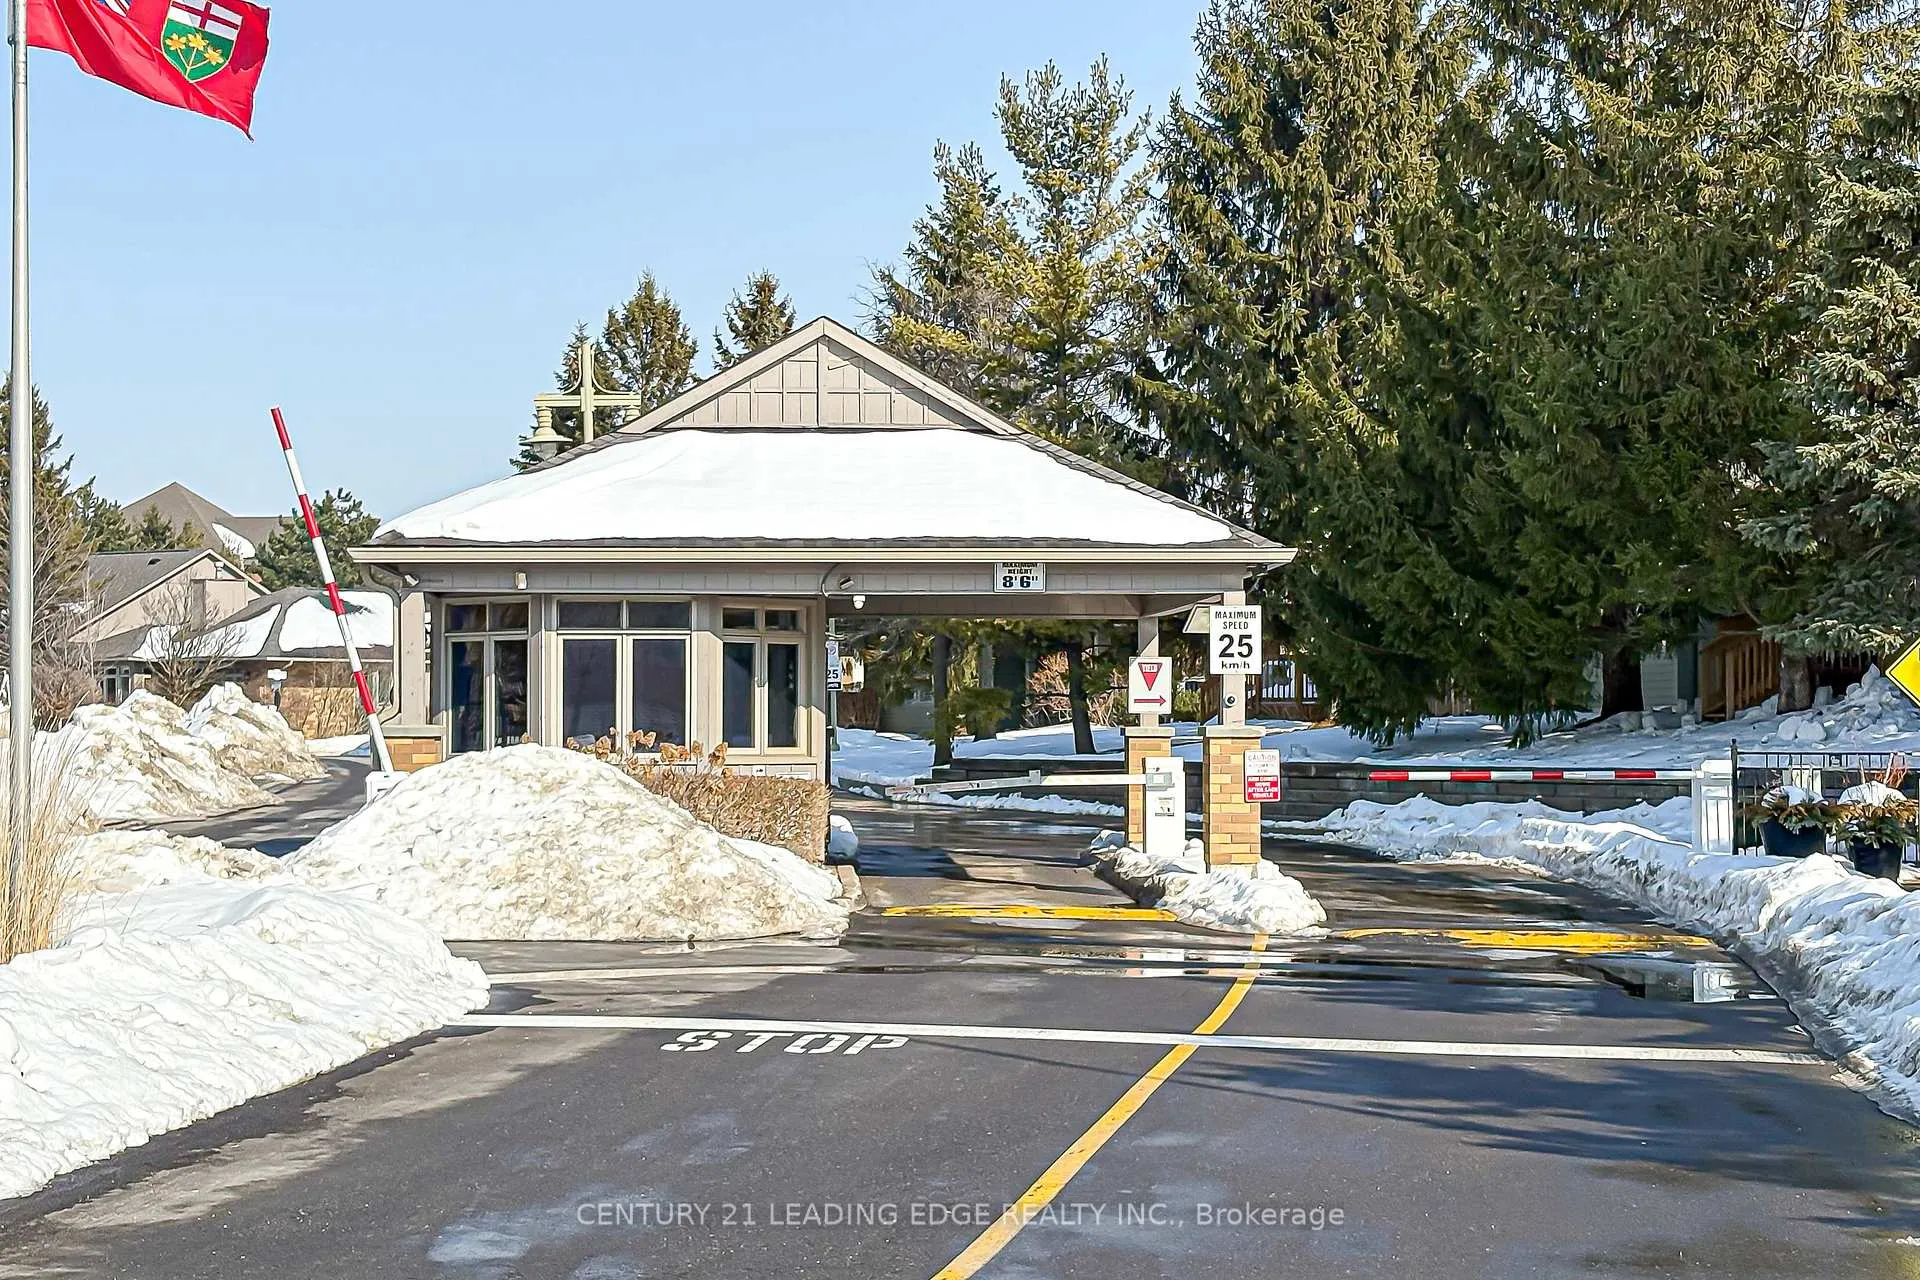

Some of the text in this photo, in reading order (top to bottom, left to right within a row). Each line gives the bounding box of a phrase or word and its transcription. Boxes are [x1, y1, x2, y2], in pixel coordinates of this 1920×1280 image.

[1215, 611, 1256, 619] MAXIMUM
[1223, 621, 1249, 629] SPEED
[1219, 633, 1253, 658] 25
[1222, 661, 1250, 669] km/h
[660, 1030, 910, 1055] STOP
